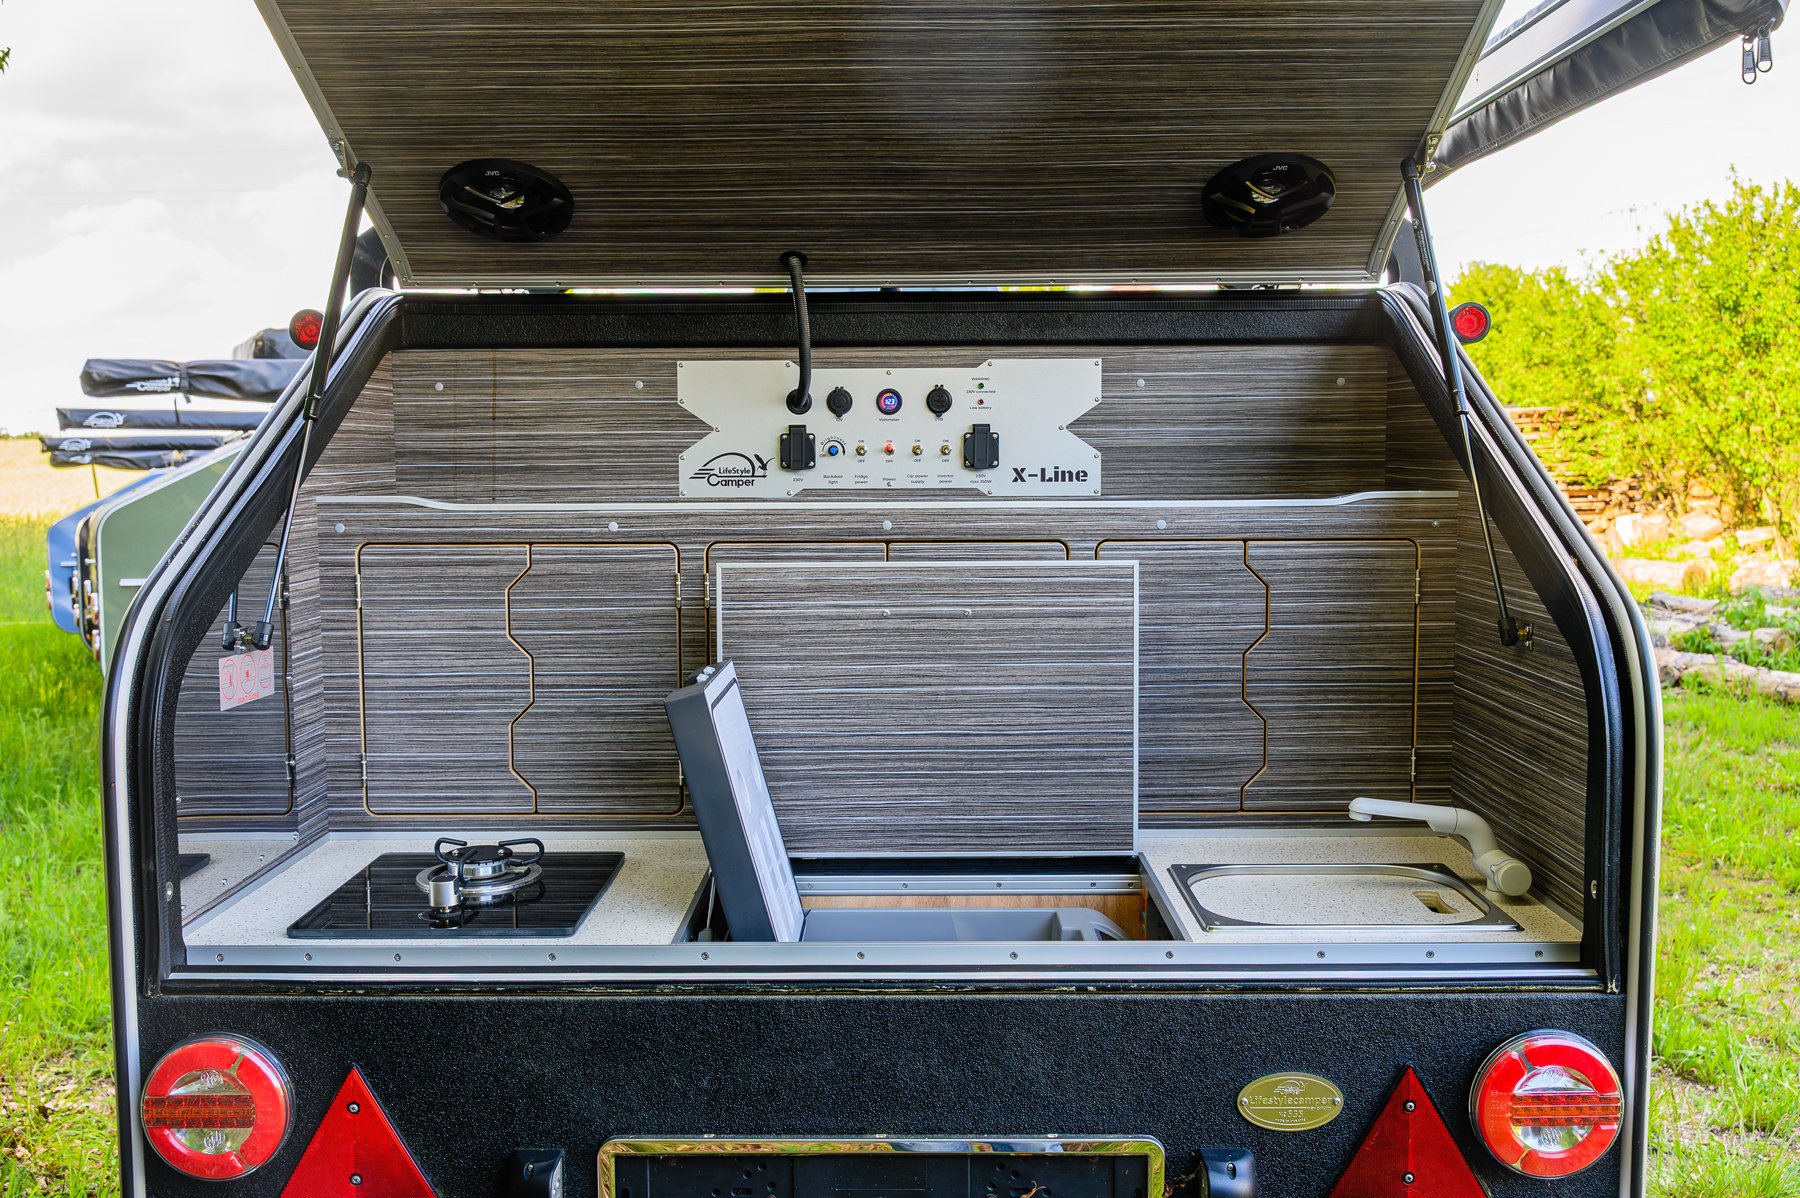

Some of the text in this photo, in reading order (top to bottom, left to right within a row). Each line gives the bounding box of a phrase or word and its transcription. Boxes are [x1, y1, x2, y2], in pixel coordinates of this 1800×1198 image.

[820, 435, 847, 446] Brightness
[719, 467, 751, 475] LifeStyle
[1011, 465, 1088, 482] X-Line
[707, 473, 755, 488] Camper
[1249, 1095, 1333, 1107] Lifestylecamper
